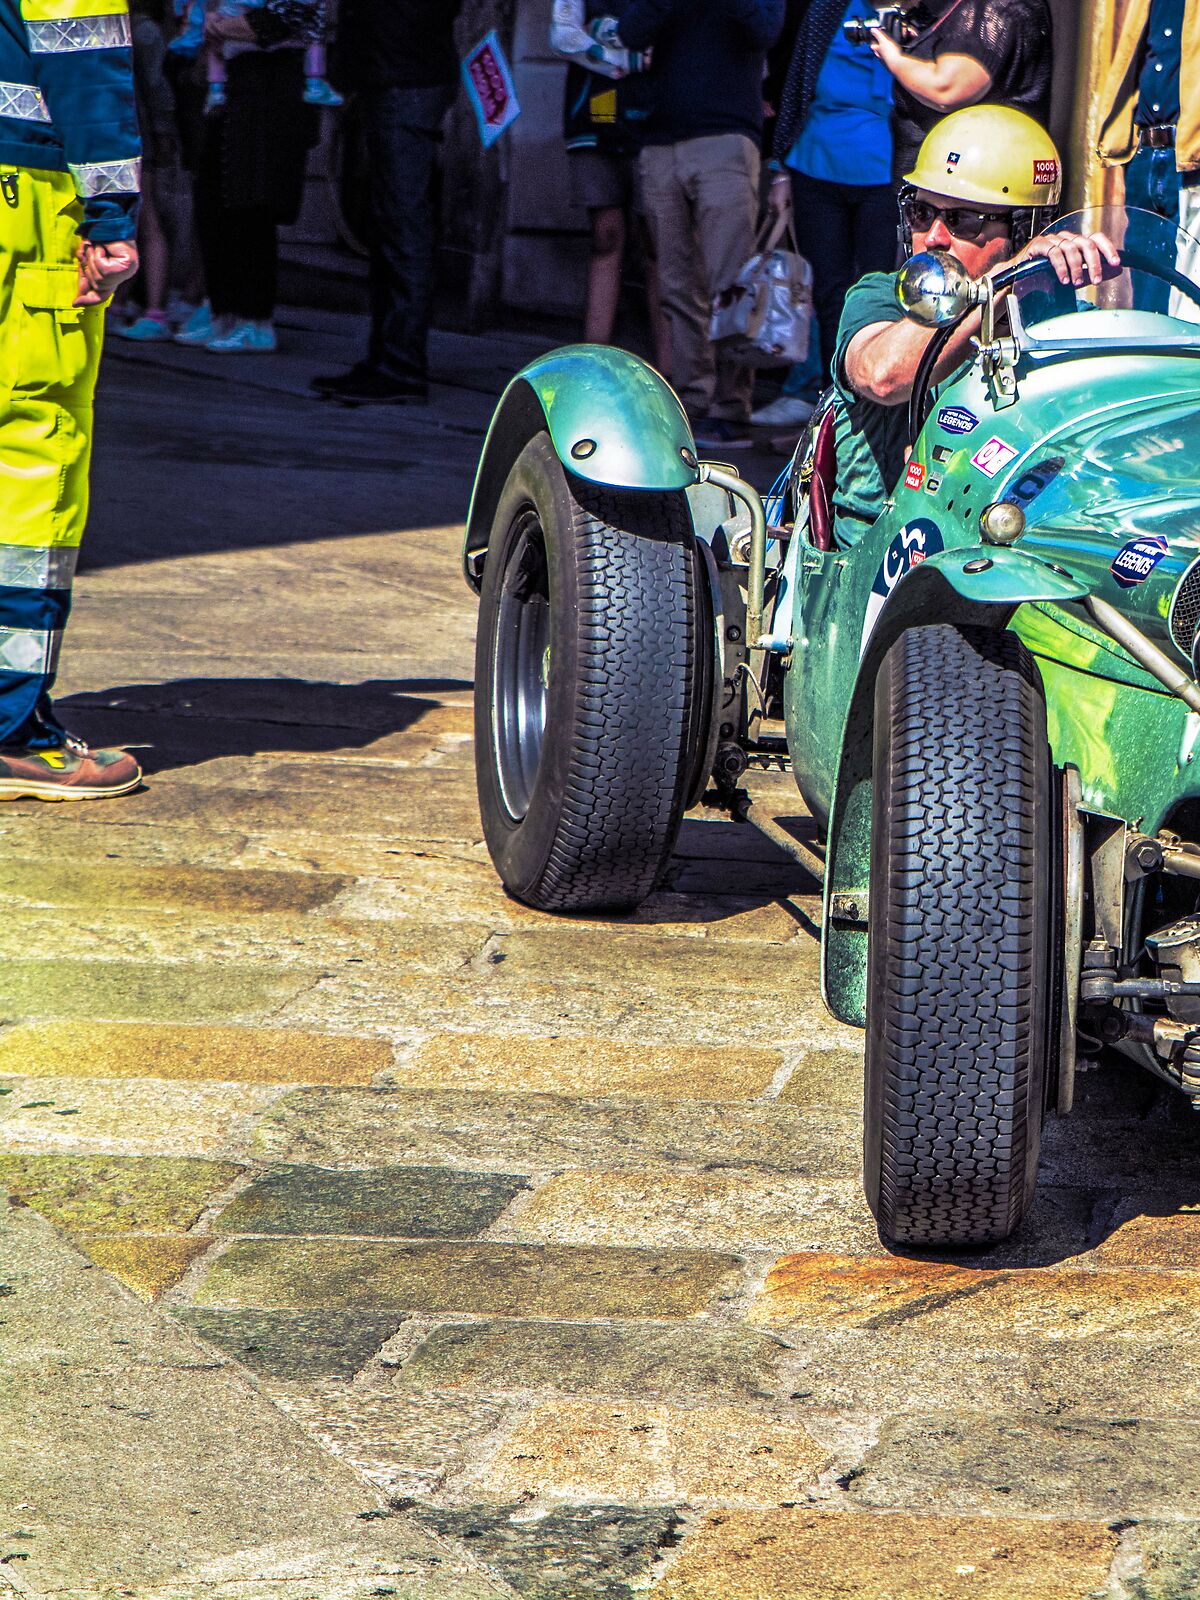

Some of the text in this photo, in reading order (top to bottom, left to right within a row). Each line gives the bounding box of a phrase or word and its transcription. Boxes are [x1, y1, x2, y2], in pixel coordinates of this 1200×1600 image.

[1036, 161, 1055, 172] 1000
[939, 413, 974, 431] LEGENDS
[1115, 550, 1155, 575] LEGENDS
